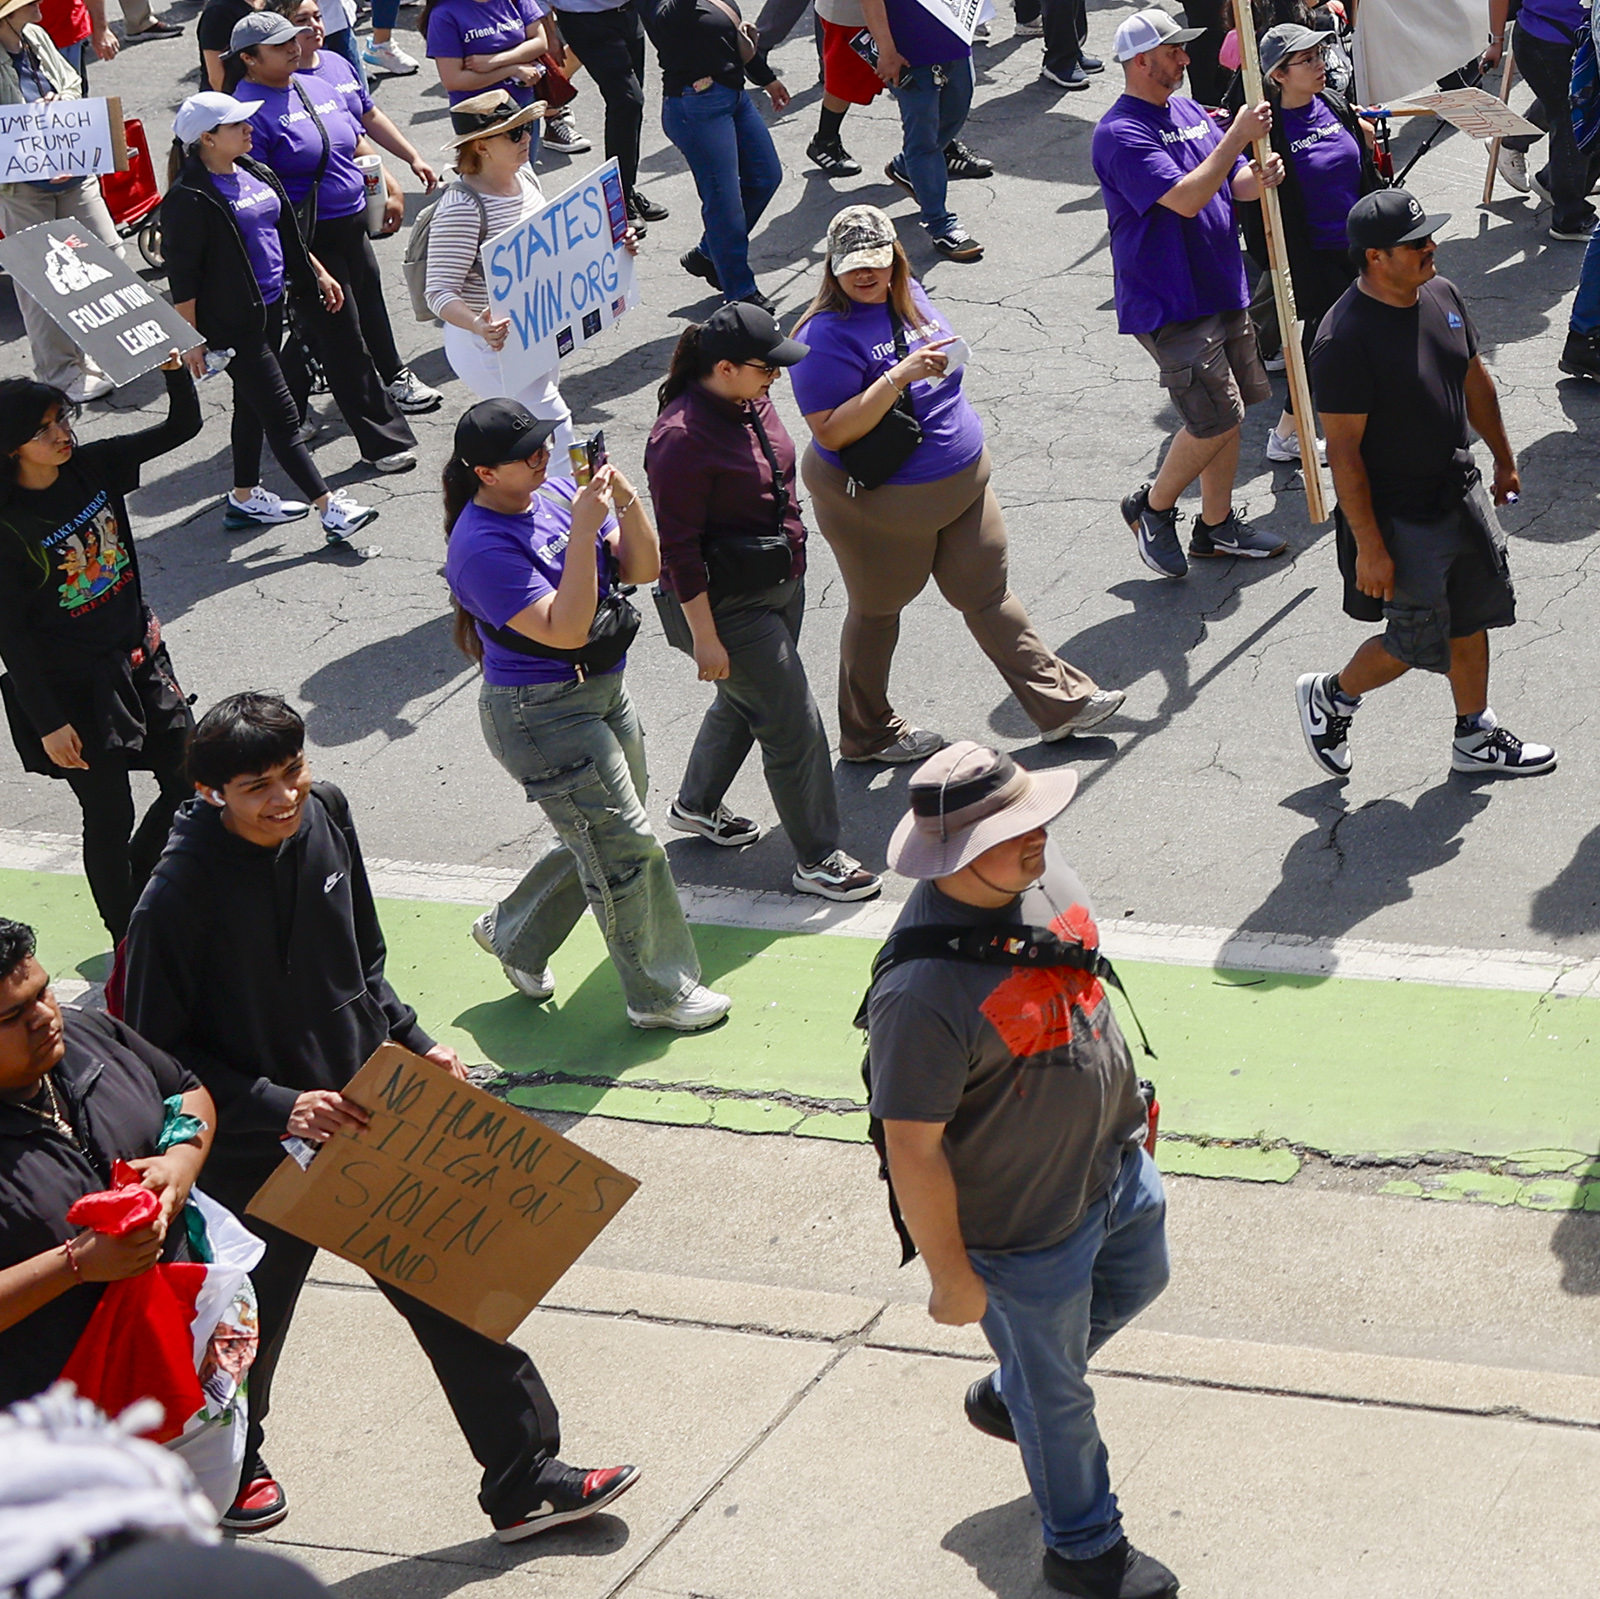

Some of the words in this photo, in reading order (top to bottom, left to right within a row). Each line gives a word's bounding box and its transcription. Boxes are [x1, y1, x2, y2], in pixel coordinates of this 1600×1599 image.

[1, 111, 91, 134] IMPEACH
[14, 132, 81, 153] TRUMP
[490, 185, 603, 303] STATES
[67, 292, 129, 334] FOLLOW
[115, 282, 155, 310] YOUR
[510, 251, 619, 352] WIN.ORG
[115, 319, 171, 356] LEADER
[41, 520, 74, 549] MAKE
[378, 1063, 419, 1114] NO
[433, 1091, 552, 1186] HUMAN
[550, 1154, 609, 1216] IS
[335, 1161, 503, 1256] STOLEN
[508, 1185, 562, 1226] ON
[340, 1230, 438, 1284] LAND
